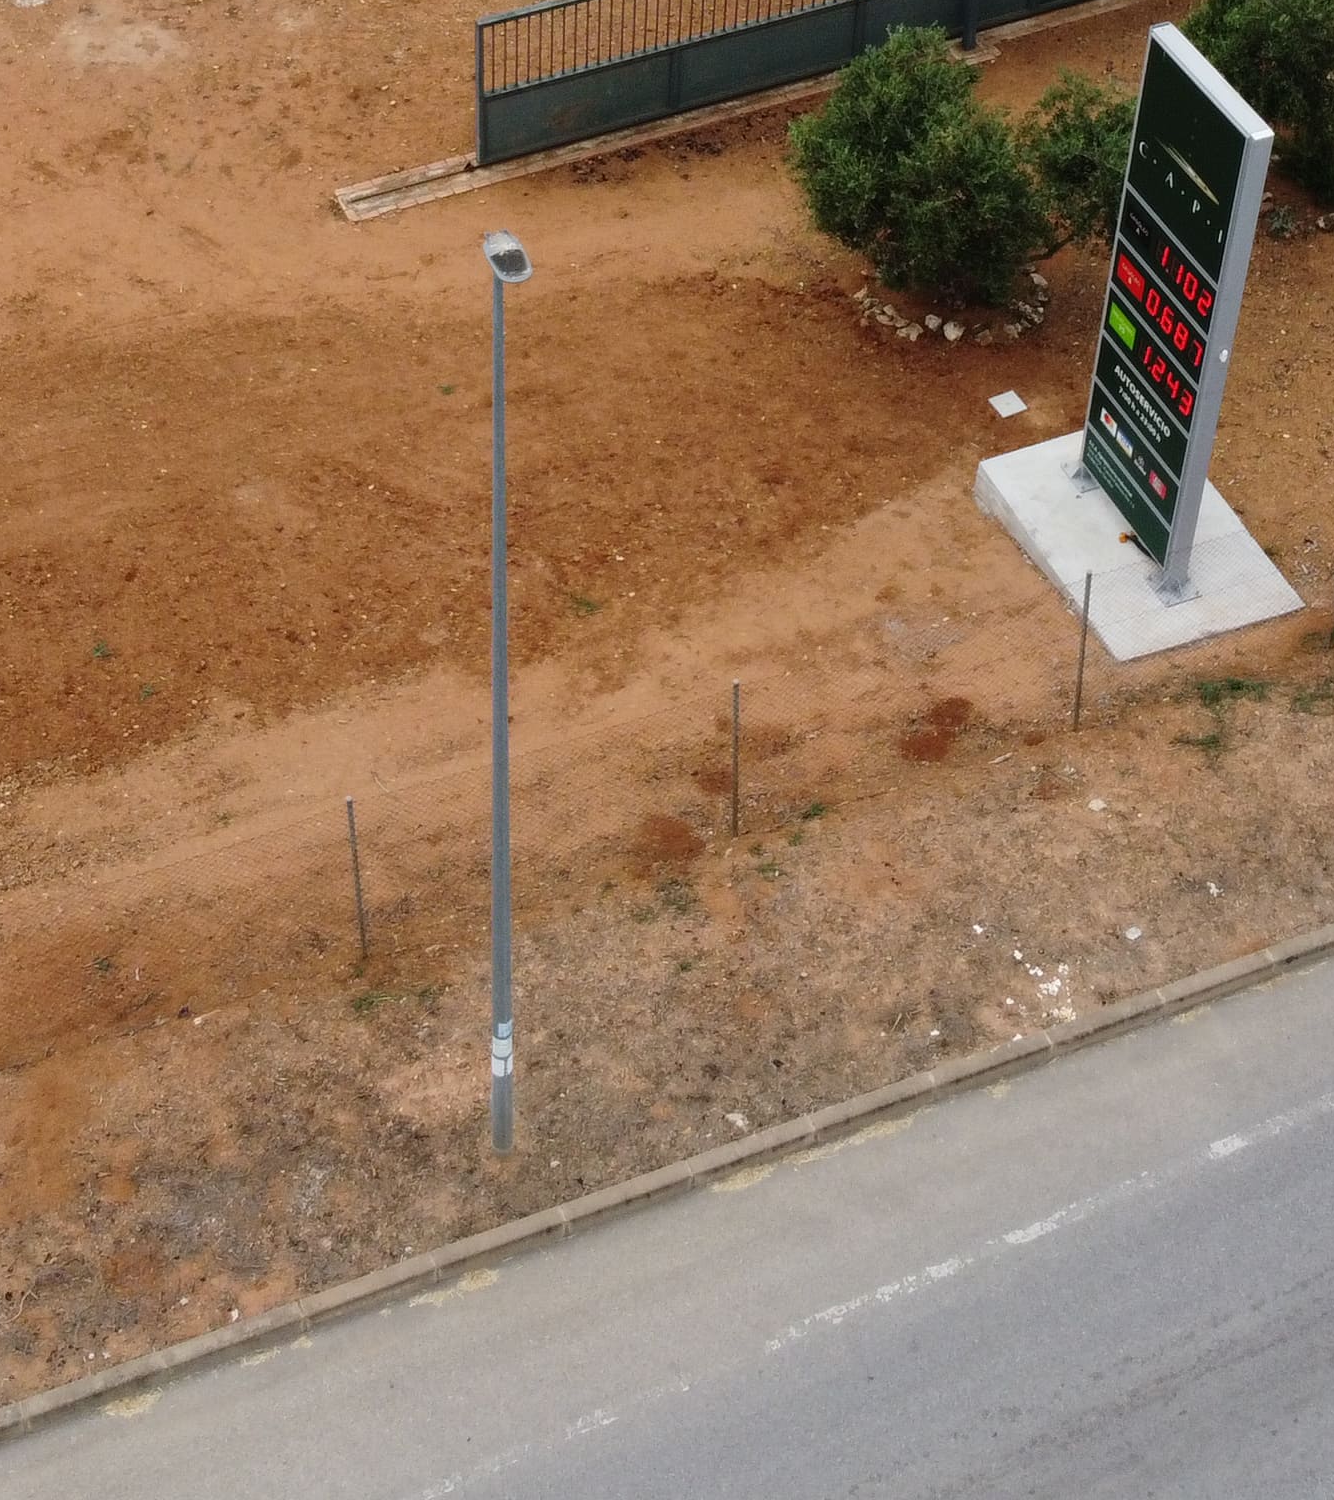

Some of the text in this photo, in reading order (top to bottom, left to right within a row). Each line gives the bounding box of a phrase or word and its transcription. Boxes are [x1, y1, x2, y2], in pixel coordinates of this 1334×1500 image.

[1160, 246, 1213, 317] 1.102
[1145, 288, 1203, 367] 0.687
[1114, 365, 1171, 438] AUTOSERVICIO
[1143, 346, 1194, 416] 1.243
